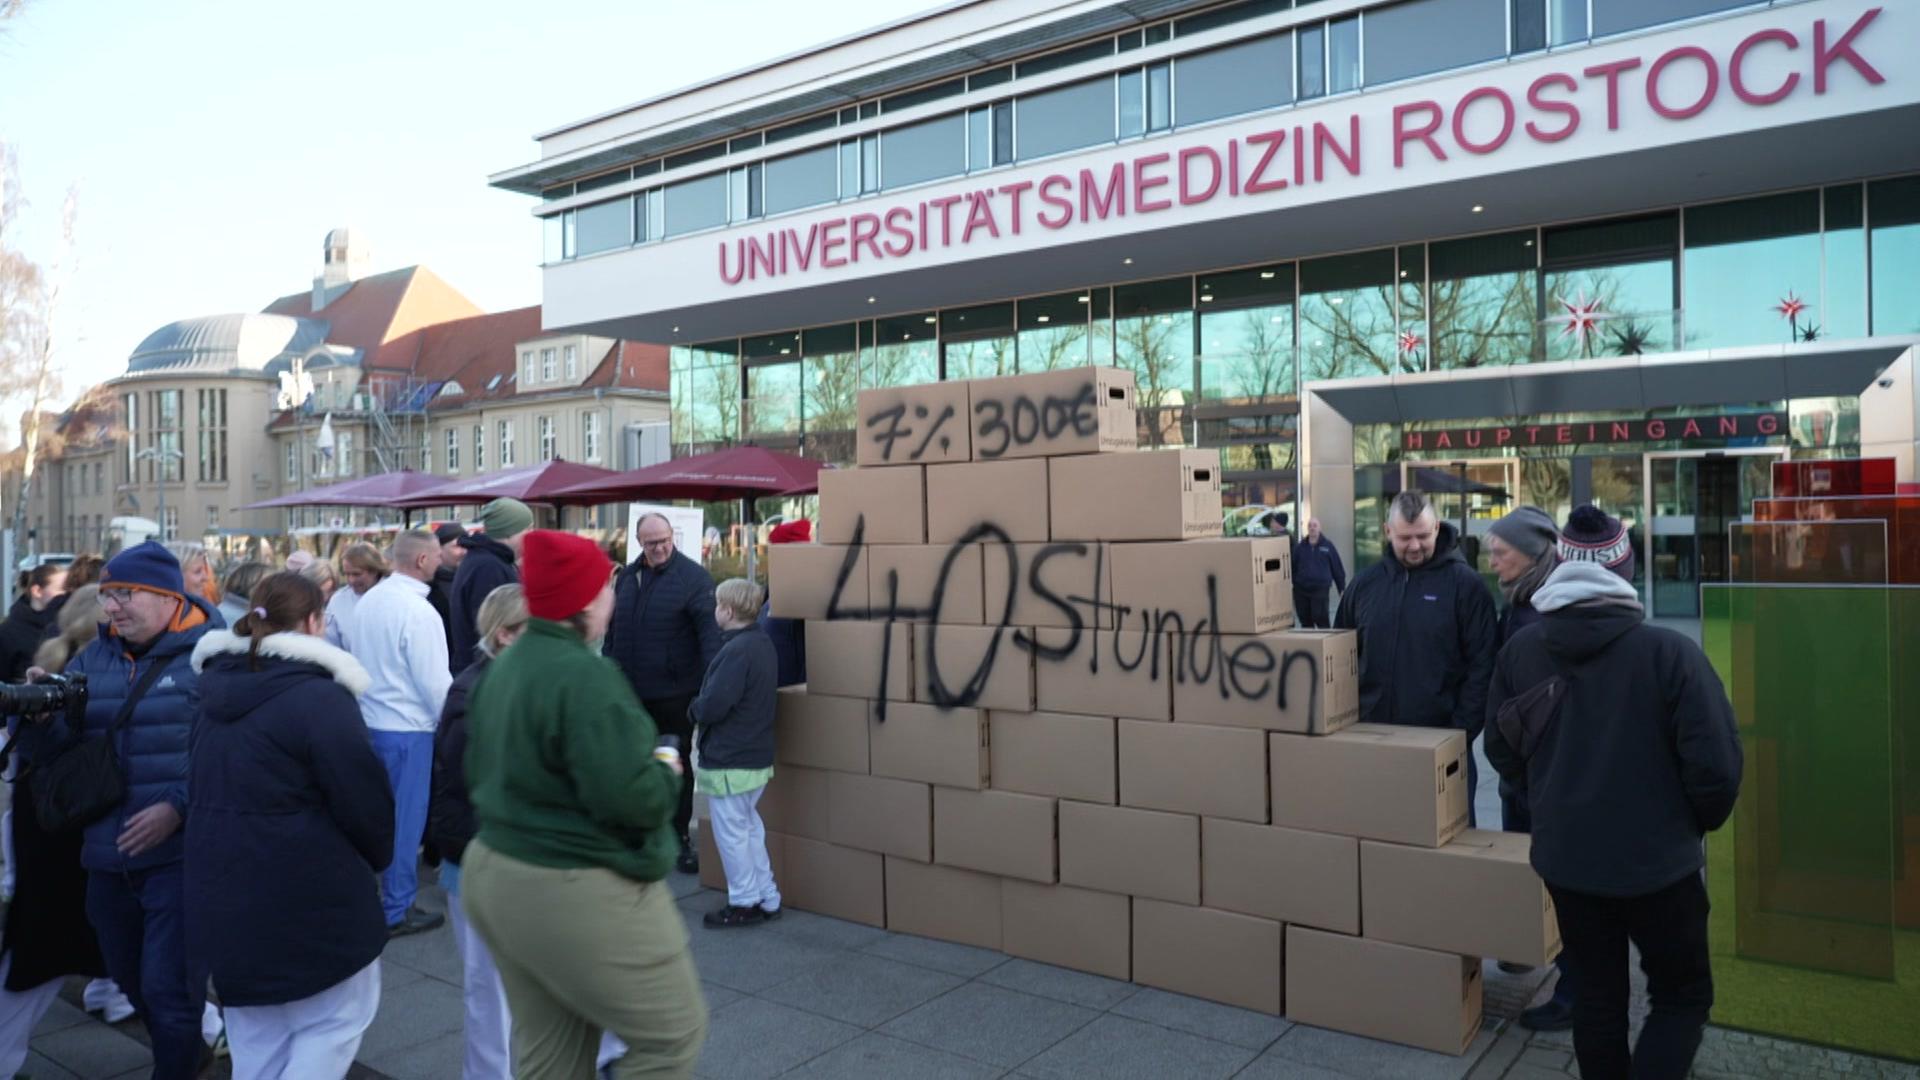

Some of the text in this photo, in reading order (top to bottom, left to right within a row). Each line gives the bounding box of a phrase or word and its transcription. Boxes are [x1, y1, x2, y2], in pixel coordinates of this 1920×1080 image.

[719, 8, 1884, 284] UNIVERSITÄTSMEDIZIN ROSTOCK
[866, 382, 1099, 461] 7% 300€
[1406, 414, 1778, 449] HAUPTEINGANG
[824, 512, 1320, 737] 40 Stunden
